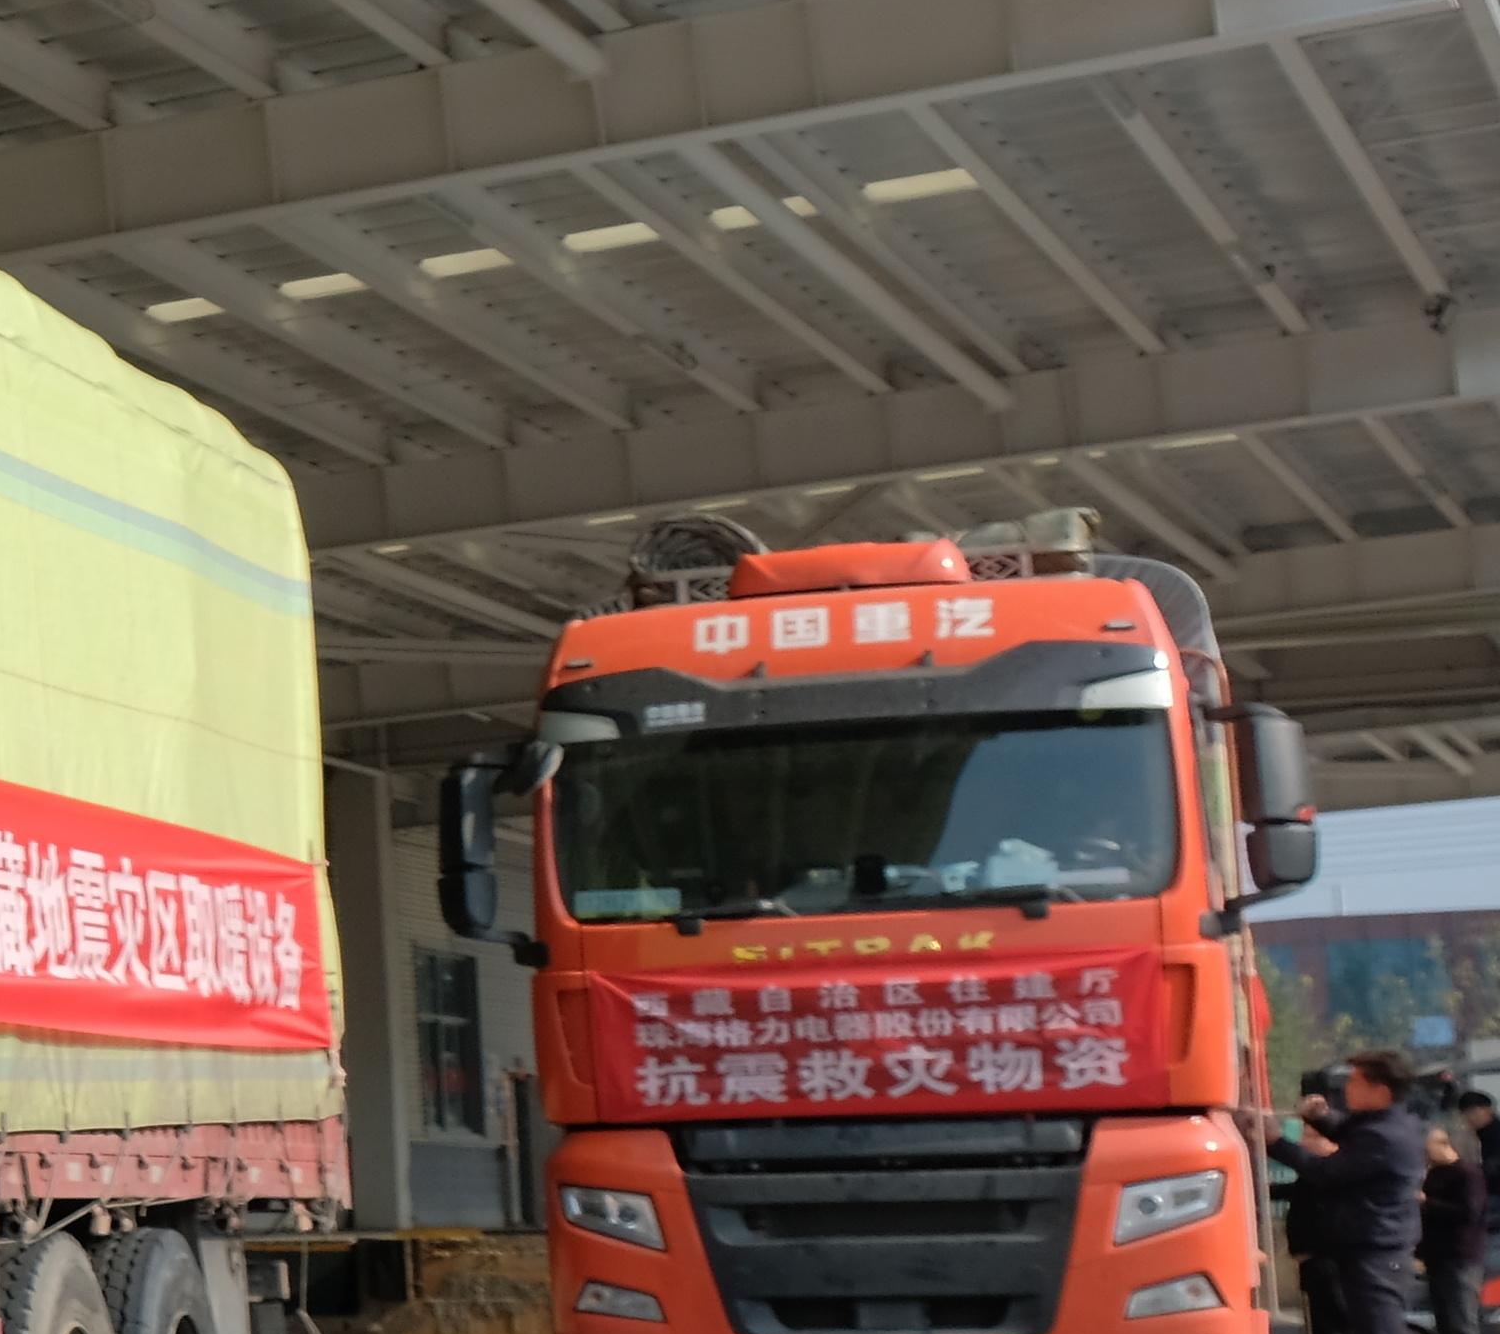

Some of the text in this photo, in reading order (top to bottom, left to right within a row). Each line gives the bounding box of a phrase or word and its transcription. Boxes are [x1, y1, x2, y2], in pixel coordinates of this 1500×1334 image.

[694, 597, 996, 656] 中国重汽
[633, 968, 1119, 1019] 西藏自治区住建厅
[635, 998, 1125, 1050] 珠海格力电器股份有限公司
[634, 1036, 1131, 1107] 抗震救灾物资
